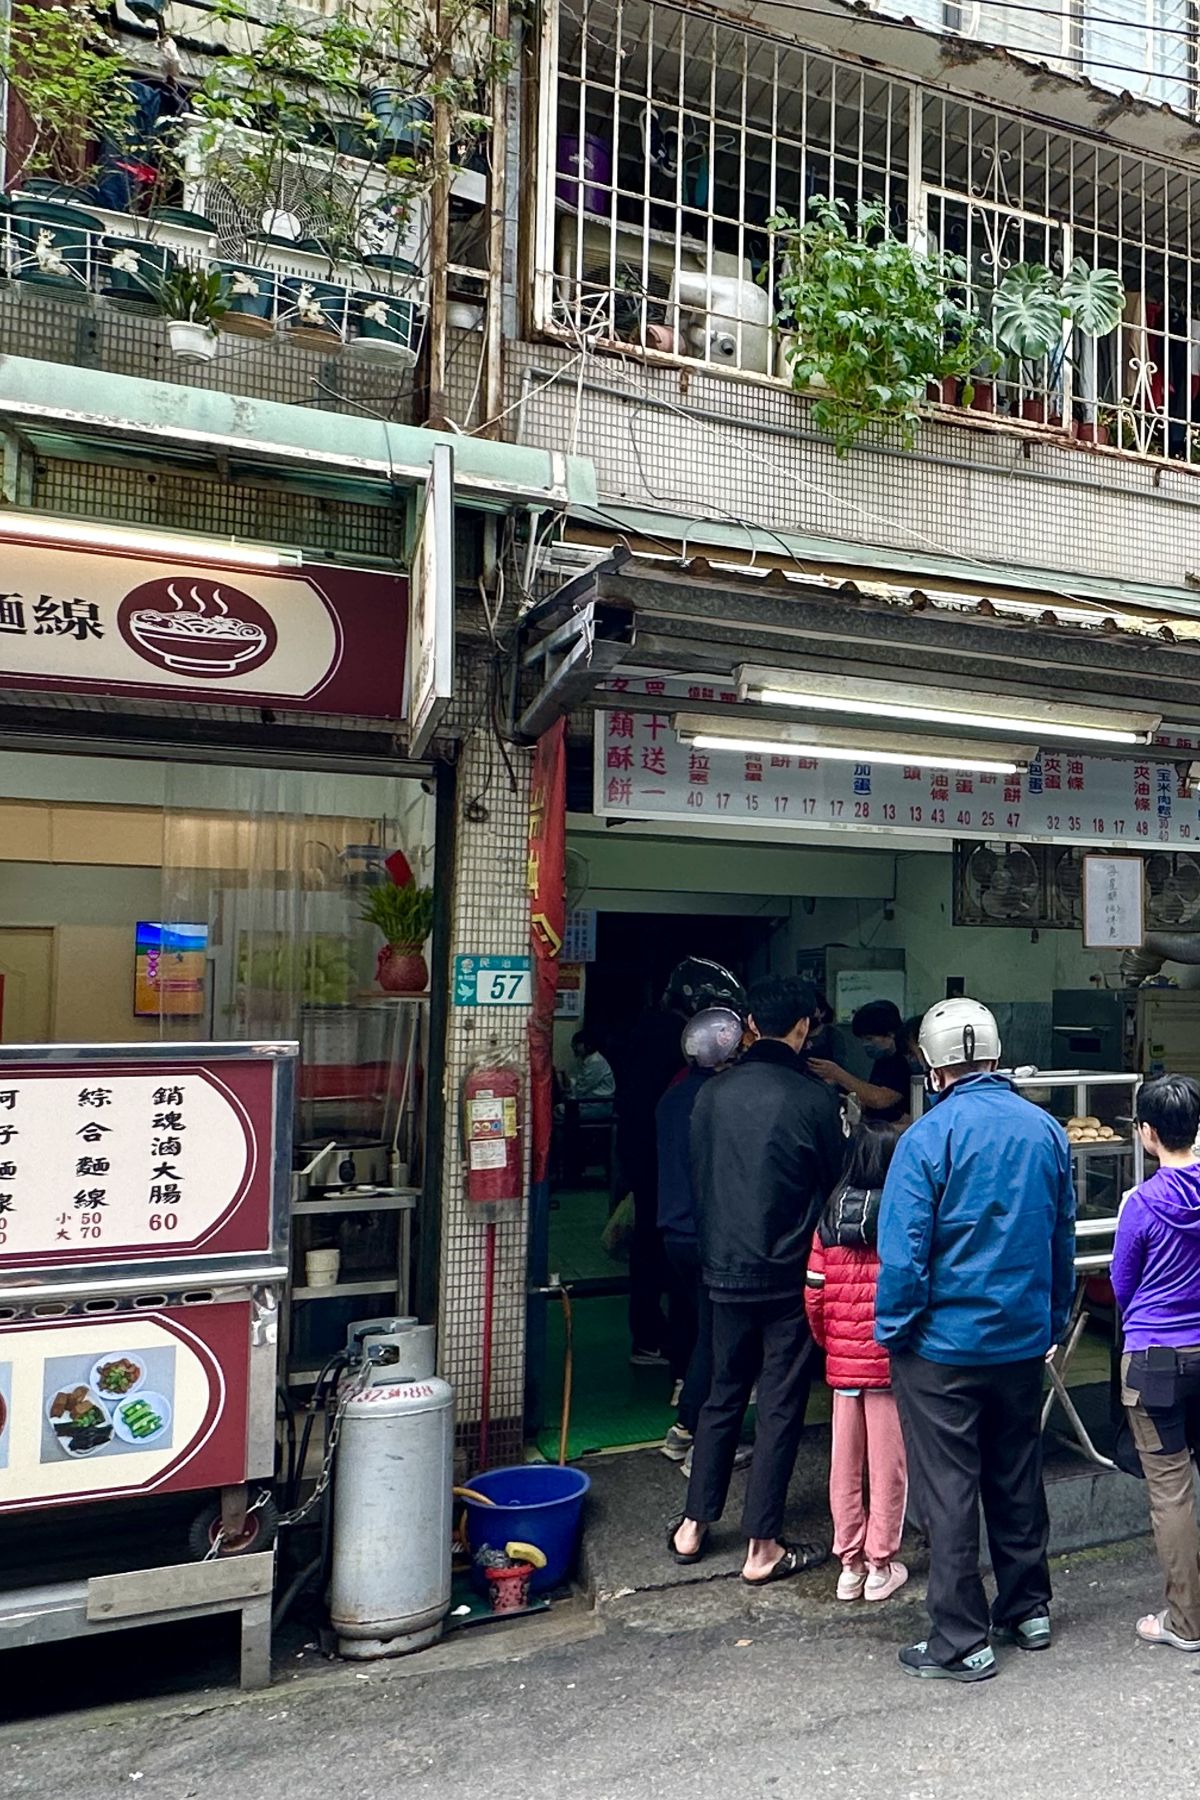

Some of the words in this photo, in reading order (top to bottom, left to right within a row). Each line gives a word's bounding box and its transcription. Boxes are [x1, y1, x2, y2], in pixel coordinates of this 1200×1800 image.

[687, 790, 704, 807] 40
[716, 792, 730, 809] 17
[746, 794, 760, 811] 15
[774, 796, 789, 812] 17
[802, 798, 817, 815] 17
[829, 800, 845, 816] 17
[853, 801, 871, 818] 28
[882, 803, 897, 820] 13
[909, 806, 922, 822] 13
[930, 808, 946, 824] 43
[956, 810, 972, 825] 40
[981, 811, 996, 827] 25
[1006, 813, 1021, 828] 47
[1046, 815, 1061, 831] 32
[1068, 816, 1082, 832] 35
[1092, 818, 1105, 834] 18
[1113, 820, 1126, 835] 17
[1135, 821, 1149, 837] 48
[1179, 824, 1191, 839] 50
[490, 974, 524, 999] 57
[73, 1087, 114, 1210] 綜合麵線
[148, 1085, 187, 1205] 銷魂滷大腸
[55, 1211, 73, 1225] 小
[80, 1211, 103, 1226] 50
[148, 1212, 179, 1232] 60
[55, 1227, 73, 1241] 大
[79, 1226, 102, 1240] 70
